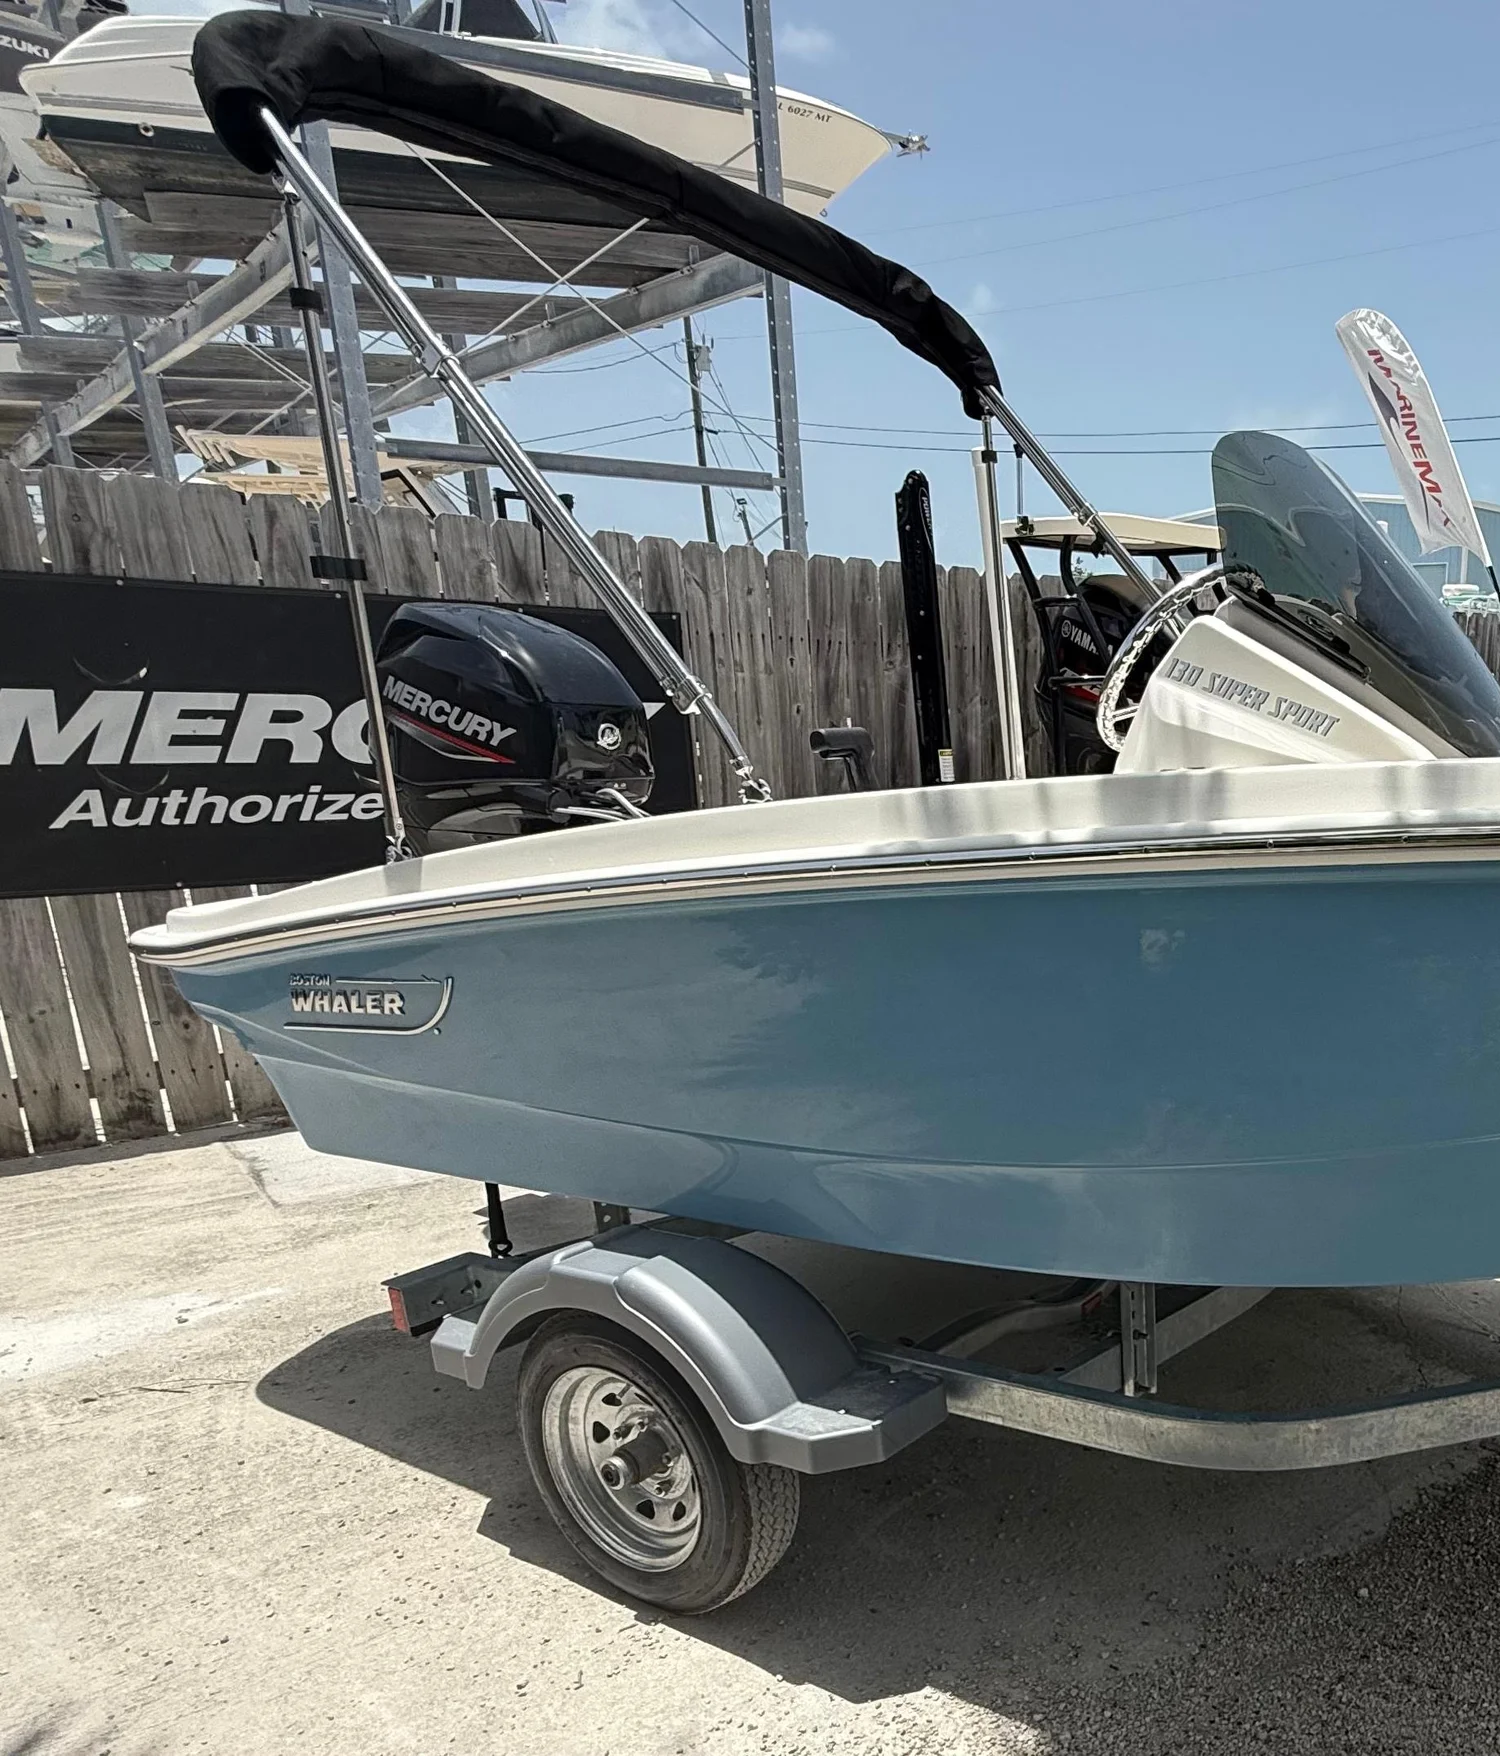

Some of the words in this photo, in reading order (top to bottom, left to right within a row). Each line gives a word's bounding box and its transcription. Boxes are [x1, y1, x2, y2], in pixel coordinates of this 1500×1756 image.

[787, 106, 814, 118] 6027
[814, 112, 834, 123] MT
[1164, 657, 1205, 688] 130
[1201, 671, 1270, 712] SUPER
[1267, 695, 1341, 737] SPORT
[382, 675, 518, 748] MERCURY
[289, 972, 332, 987] BOSTON
[289, 988, 406, 1016] WHALER
